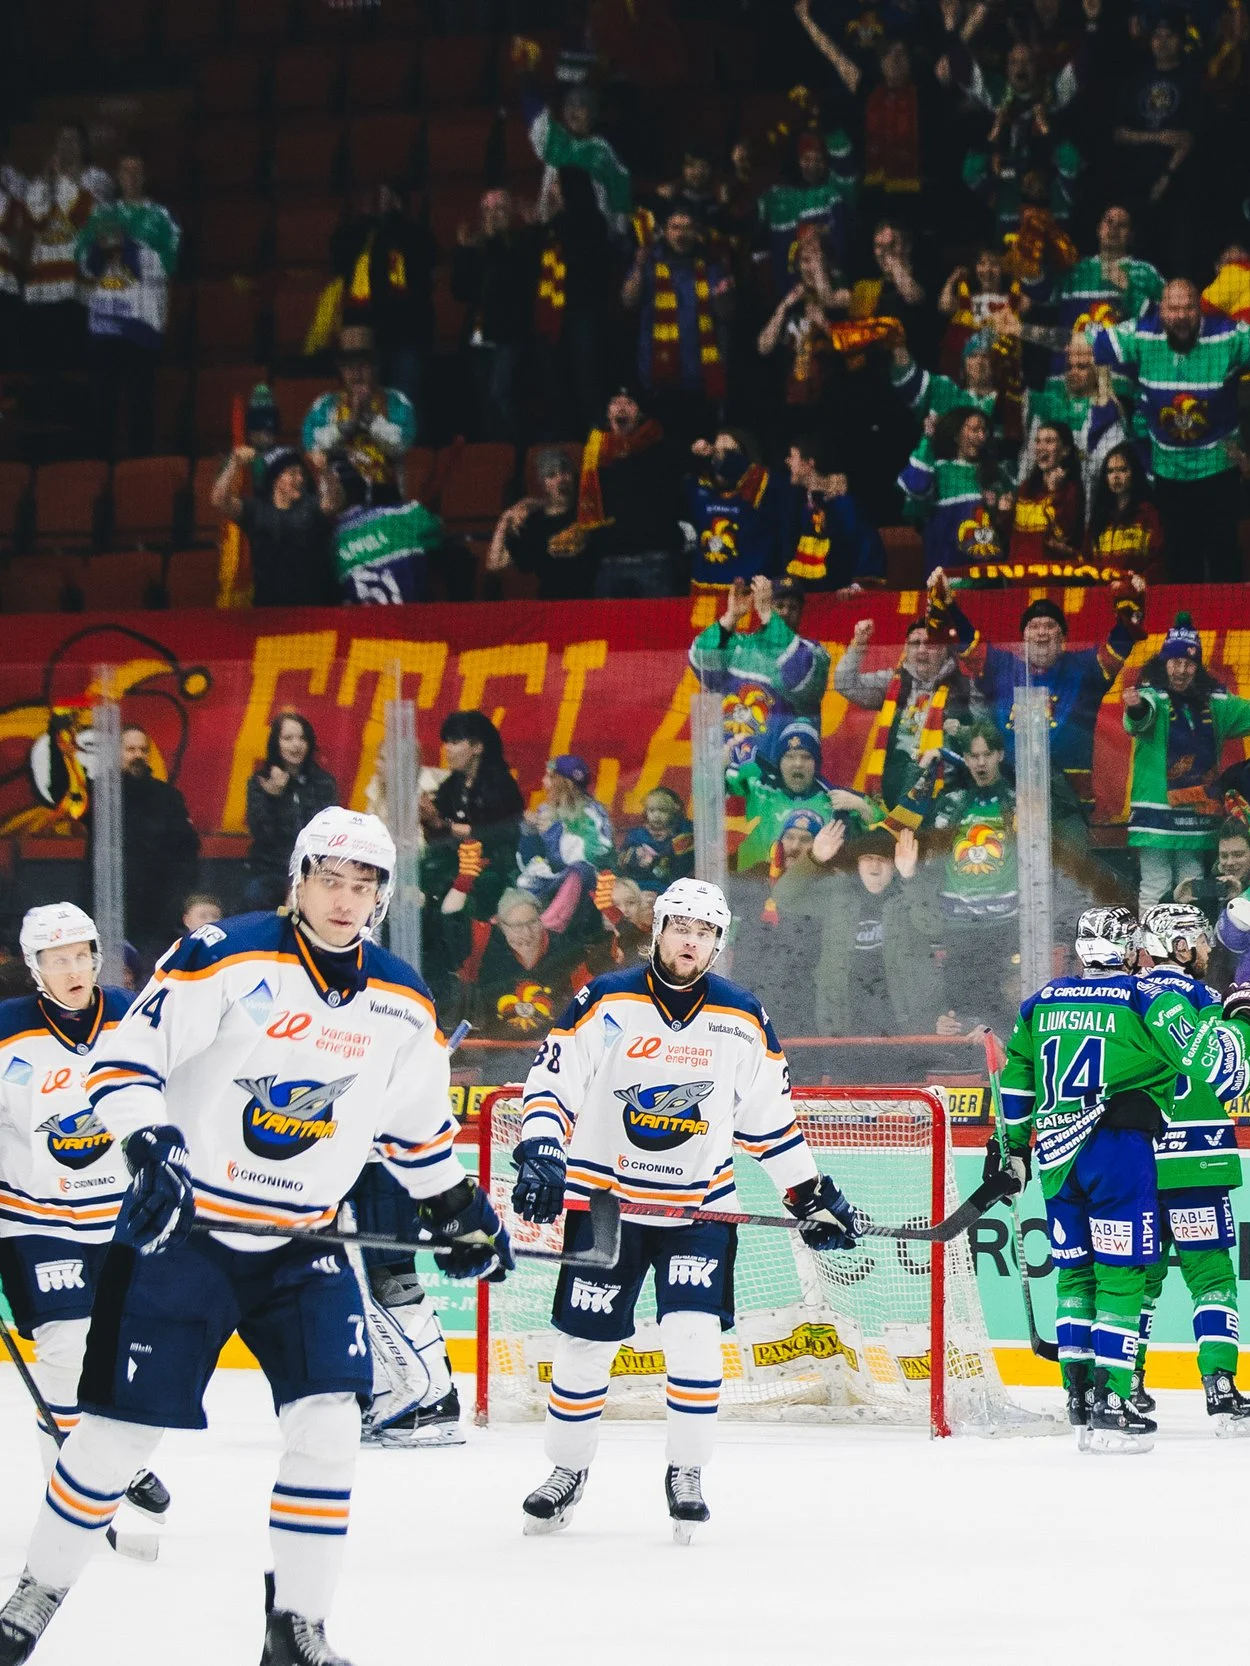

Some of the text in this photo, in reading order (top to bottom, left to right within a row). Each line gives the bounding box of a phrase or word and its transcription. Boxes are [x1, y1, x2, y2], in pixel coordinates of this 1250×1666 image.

[1054, 986, 1131, 1000] CIRCULATION
[369, 999, 402, 1019] Vantaan
[708, 1021, 733, 1035] Vantaan
[1038, 1011, 1116, 1033] LIUKSIALA
[1168, 1015, 1196, 1049] 14
[665, 1053, 708, 1067] energia
[667, 1044, 713, 1057] vantaan
[1037, 1035, 1108, 1113] 14
[251, 1107, 338, 1140] VANTAA
[629, 1110, 710, 1136] VANTAA
[631, 1160, 684, 1177] CRONIMO
[240, 1168, 304, 1193] CRONIMO
[1171, 1210, 1216, 1225] CABLE
[1222, 1196, 1235, 1238] HALTI
[1142, 1211, 1154, 1255] HALTI
[1174, 1224, 1215, 1239] CREW
